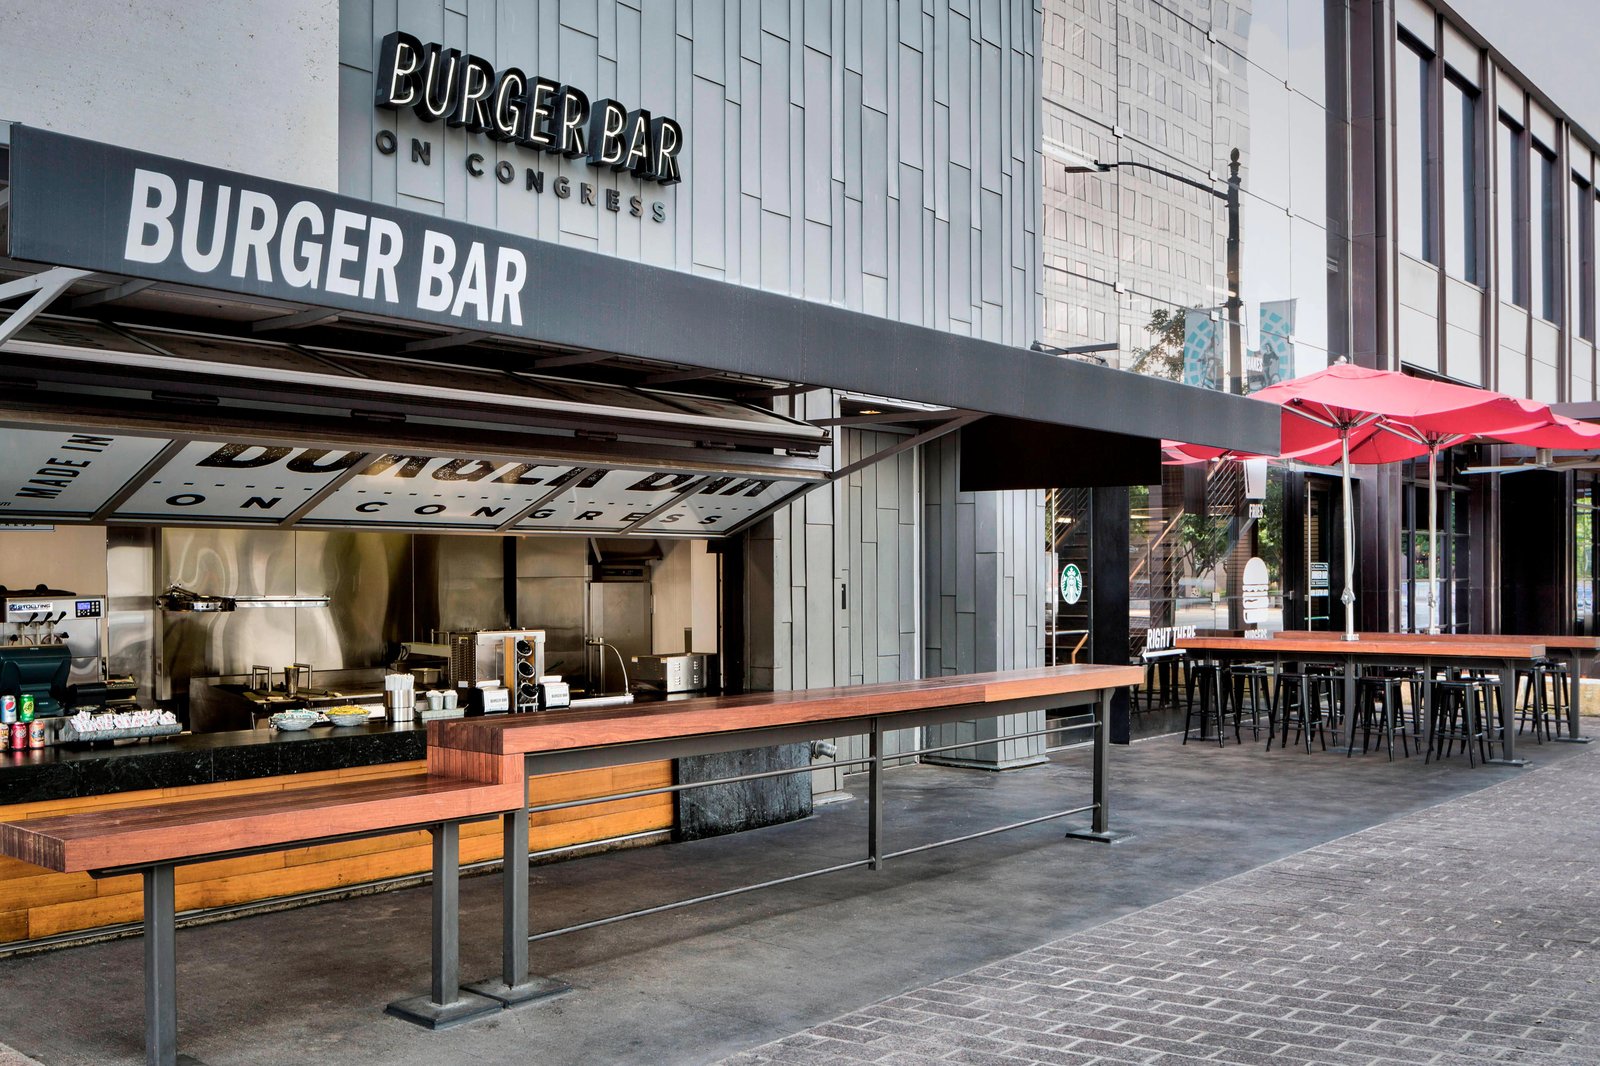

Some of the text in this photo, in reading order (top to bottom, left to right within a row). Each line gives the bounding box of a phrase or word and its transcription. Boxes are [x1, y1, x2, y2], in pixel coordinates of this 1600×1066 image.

[376, 30, 684, 186] BURGER BAR
[375, 129, 667, 223] ON CONGRESS
[124, 168, 527, 327] BURGER BAR
[15, 458, 91, 499] MADE
[61, 434, 114, 452] IN
[165, 493, 723, 526] ON CONGRESS
[1249, 503, 1264, 518] FRIES
[1146, 626, 1172, 649] RIGHT
